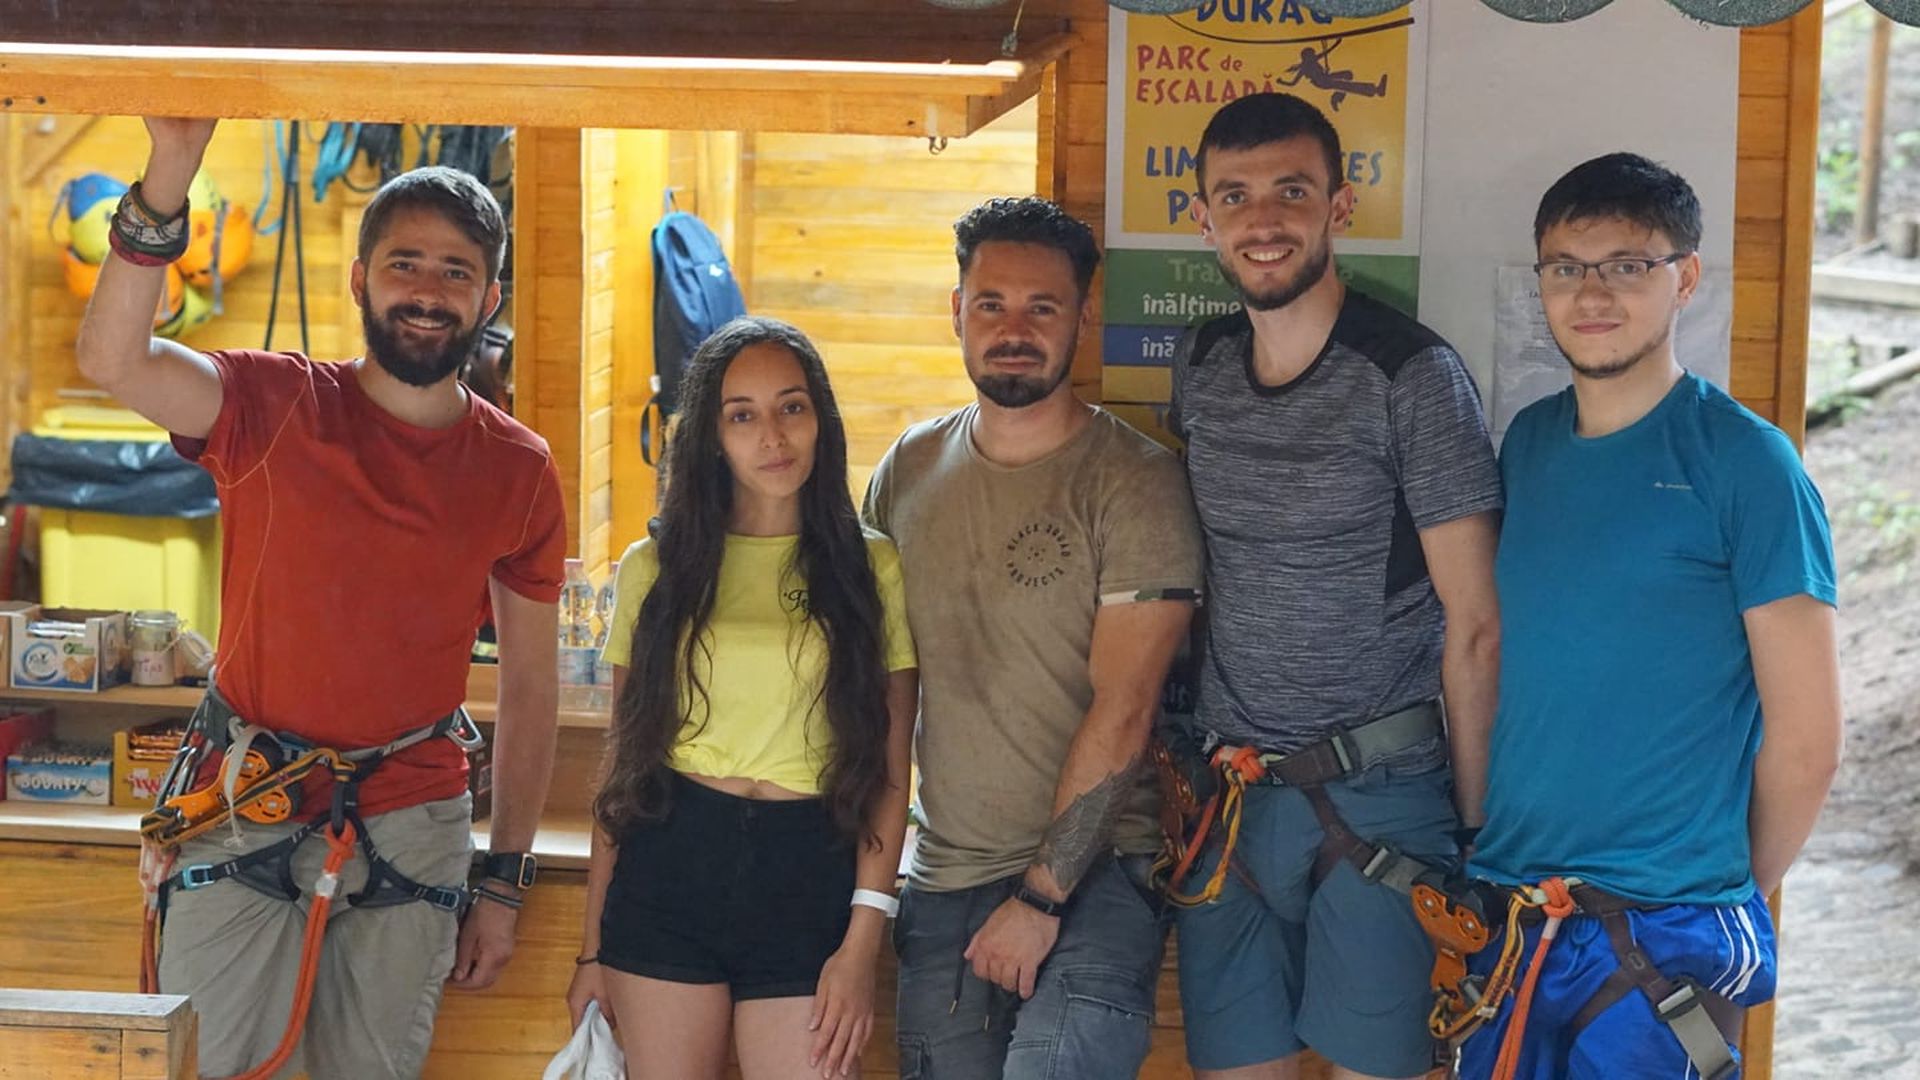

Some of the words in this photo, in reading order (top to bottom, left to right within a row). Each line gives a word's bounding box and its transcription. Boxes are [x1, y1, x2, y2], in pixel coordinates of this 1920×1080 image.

[1137, 44, 1211, 72] PARC
[1220, 54, 1243, 72] de
[1136, 73, 1275, 105] ESCALADĂ
[1146, 146, 1200, 178] LIM
